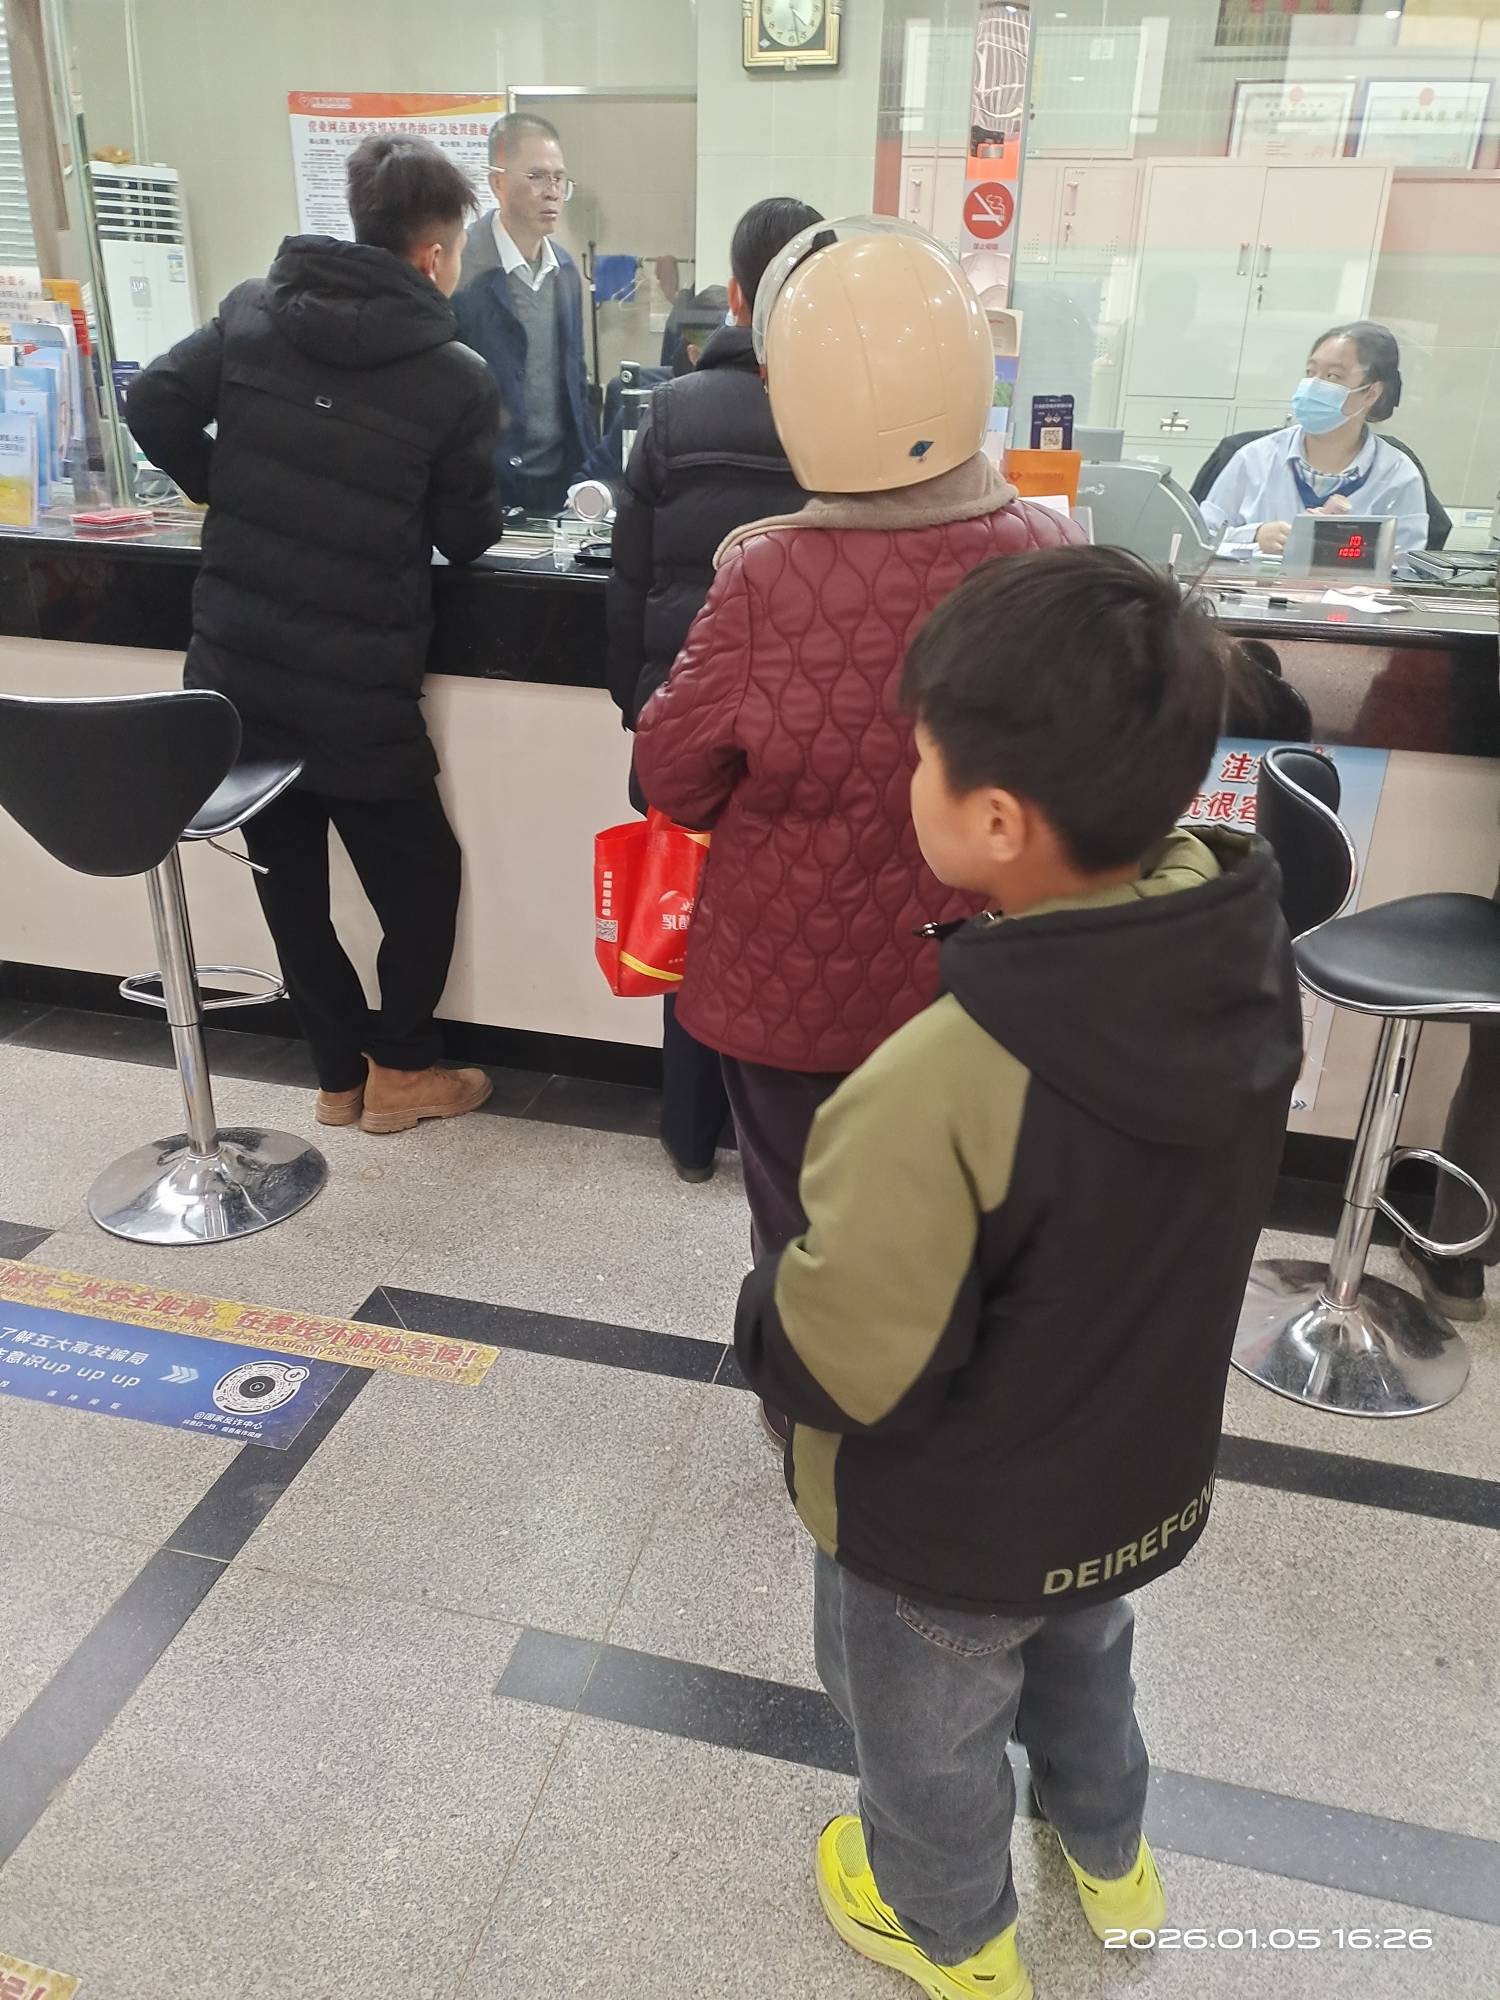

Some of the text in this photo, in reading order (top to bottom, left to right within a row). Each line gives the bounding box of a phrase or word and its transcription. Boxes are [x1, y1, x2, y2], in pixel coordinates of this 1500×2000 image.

[0, 1326, 150, 1366] 了解五大高发骗局
[76, 1367, 106, 1382] up
[111, 1374, 141, 1389] up
